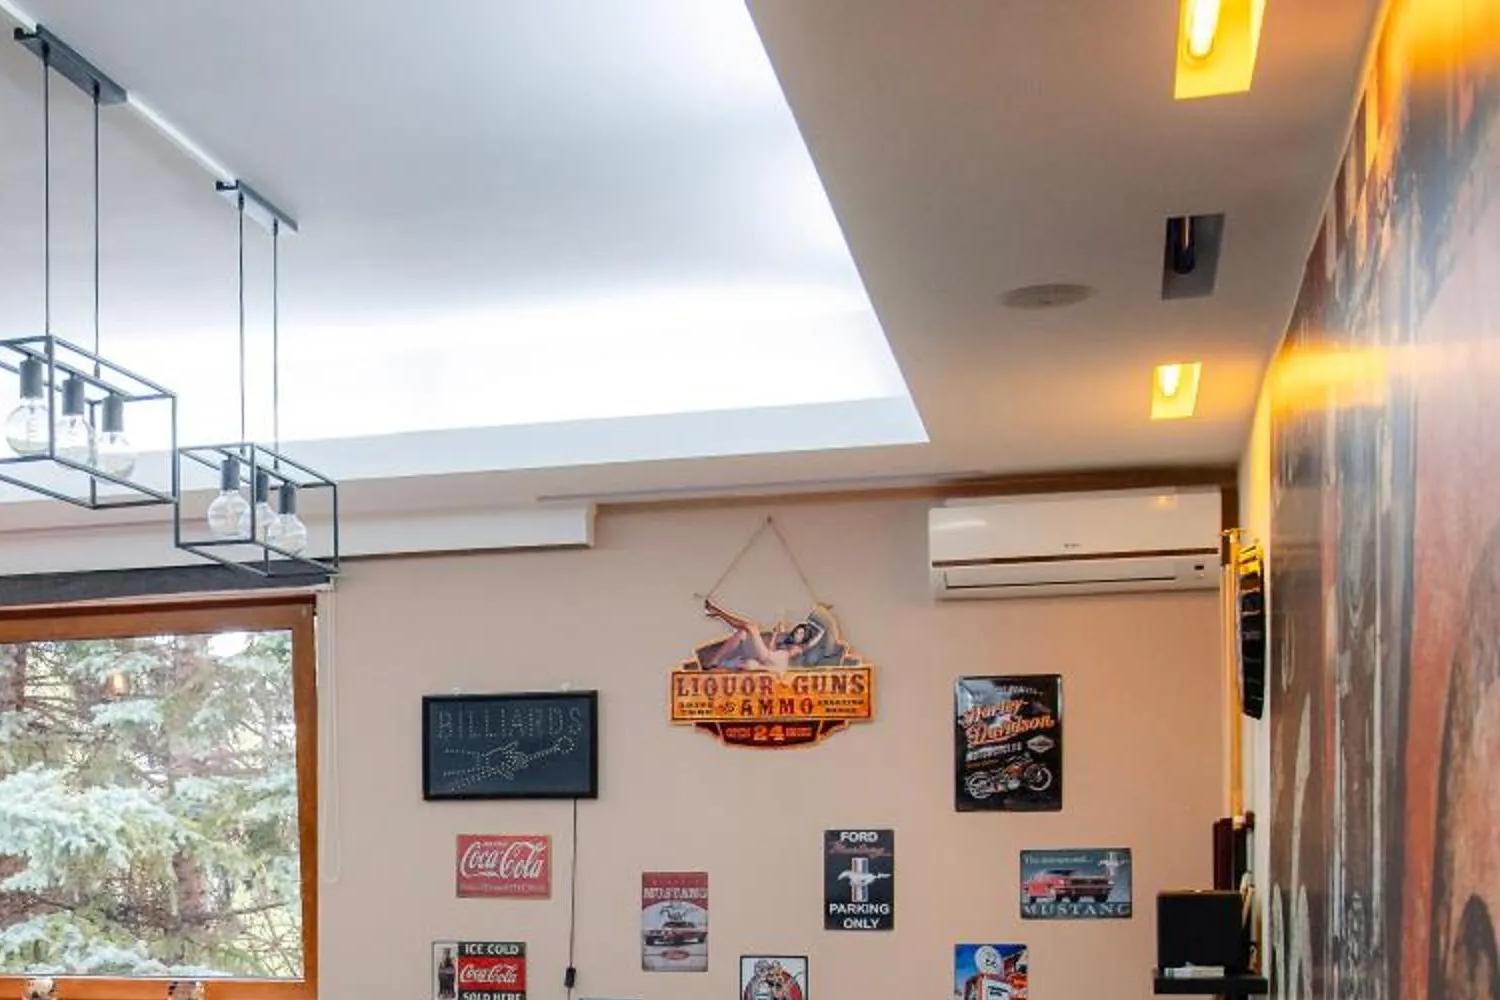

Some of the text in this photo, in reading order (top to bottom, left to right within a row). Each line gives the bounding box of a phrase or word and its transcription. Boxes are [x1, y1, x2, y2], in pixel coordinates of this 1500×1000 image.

[675, 673, 865, 699] LIQUOR GUNS
[740, 697, 813, 717] AMMO
[437, 705, 582, 739] BILLIARDS
[752, 724, 785, 741] 24
[840, 831, 879, 842] FORD
[460, 841, 547, 879] Coca-Cola
[829, 903, 890, 915] PARKING
[1024, 902, 1131, 916] MUSTANG
[843, 918, 880, 929] ONLY
[465, 943, 519, 955] ICE COLD
[460, 963, 518, 983] Coca-Cola
